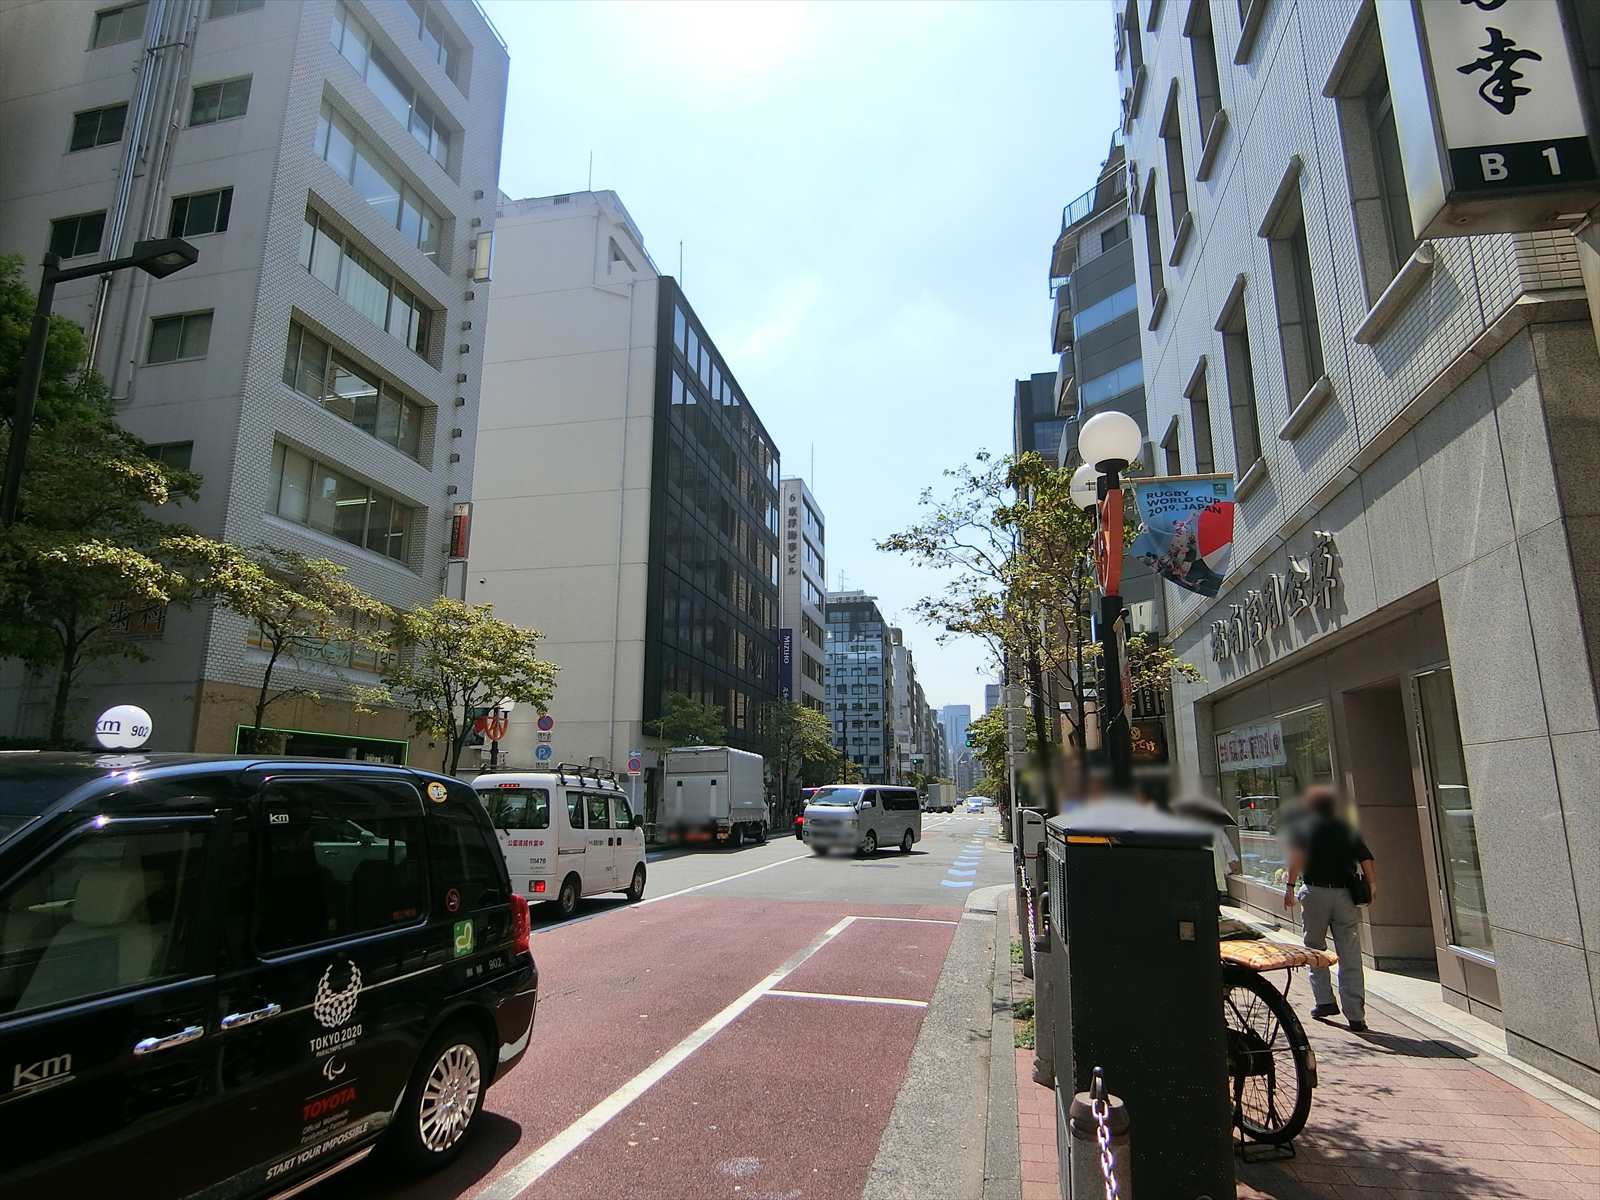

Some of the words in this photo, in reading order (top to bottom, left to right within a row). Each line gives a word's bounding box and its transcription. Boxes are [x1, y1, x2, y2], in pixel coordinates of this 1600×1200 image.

[1146, 490, 1189, 500] RUGBY
[1146, 496, 1194, 507] WORLD
[1195, 496, 1221, 505] CUP
[1181, 503, 1222, 515] JAPAN
[131, 725, 149, 737] 902
[309, 1031, 341, 1052] TOKYO
[341, 1024, 363, 1042] 2020
[303, 1087, 356, 1120] TOYOTA
[265, 1156, 297, 1180] START
[297, 1145, 321, 1165] YOUR
[321, 1121, 370, 1153] IMPOSSIBLE
